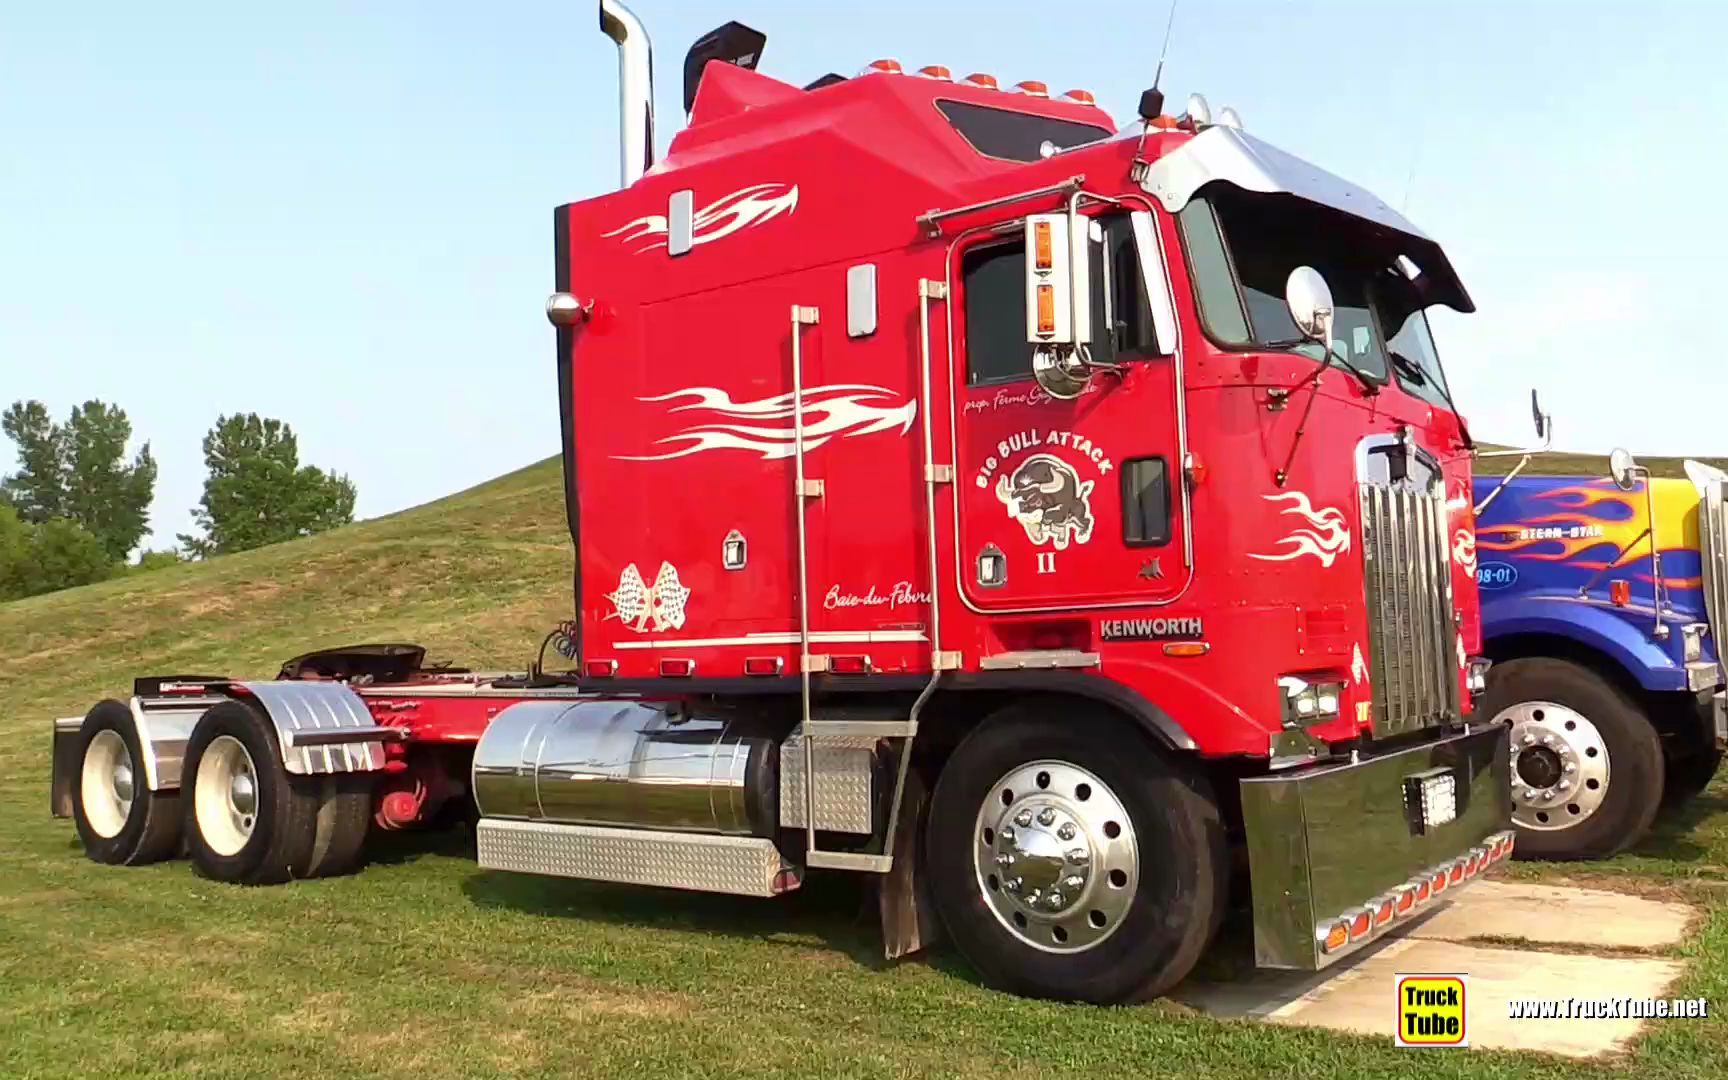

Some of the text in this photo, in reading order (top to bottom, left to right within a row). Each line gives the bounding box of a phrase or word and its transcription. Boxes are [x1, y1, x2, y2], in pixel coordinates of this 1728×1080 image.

[975, 428, 1114, 489] BIG BULL ATTACK
[1100, 616, 1203, 637] KENWORTH
